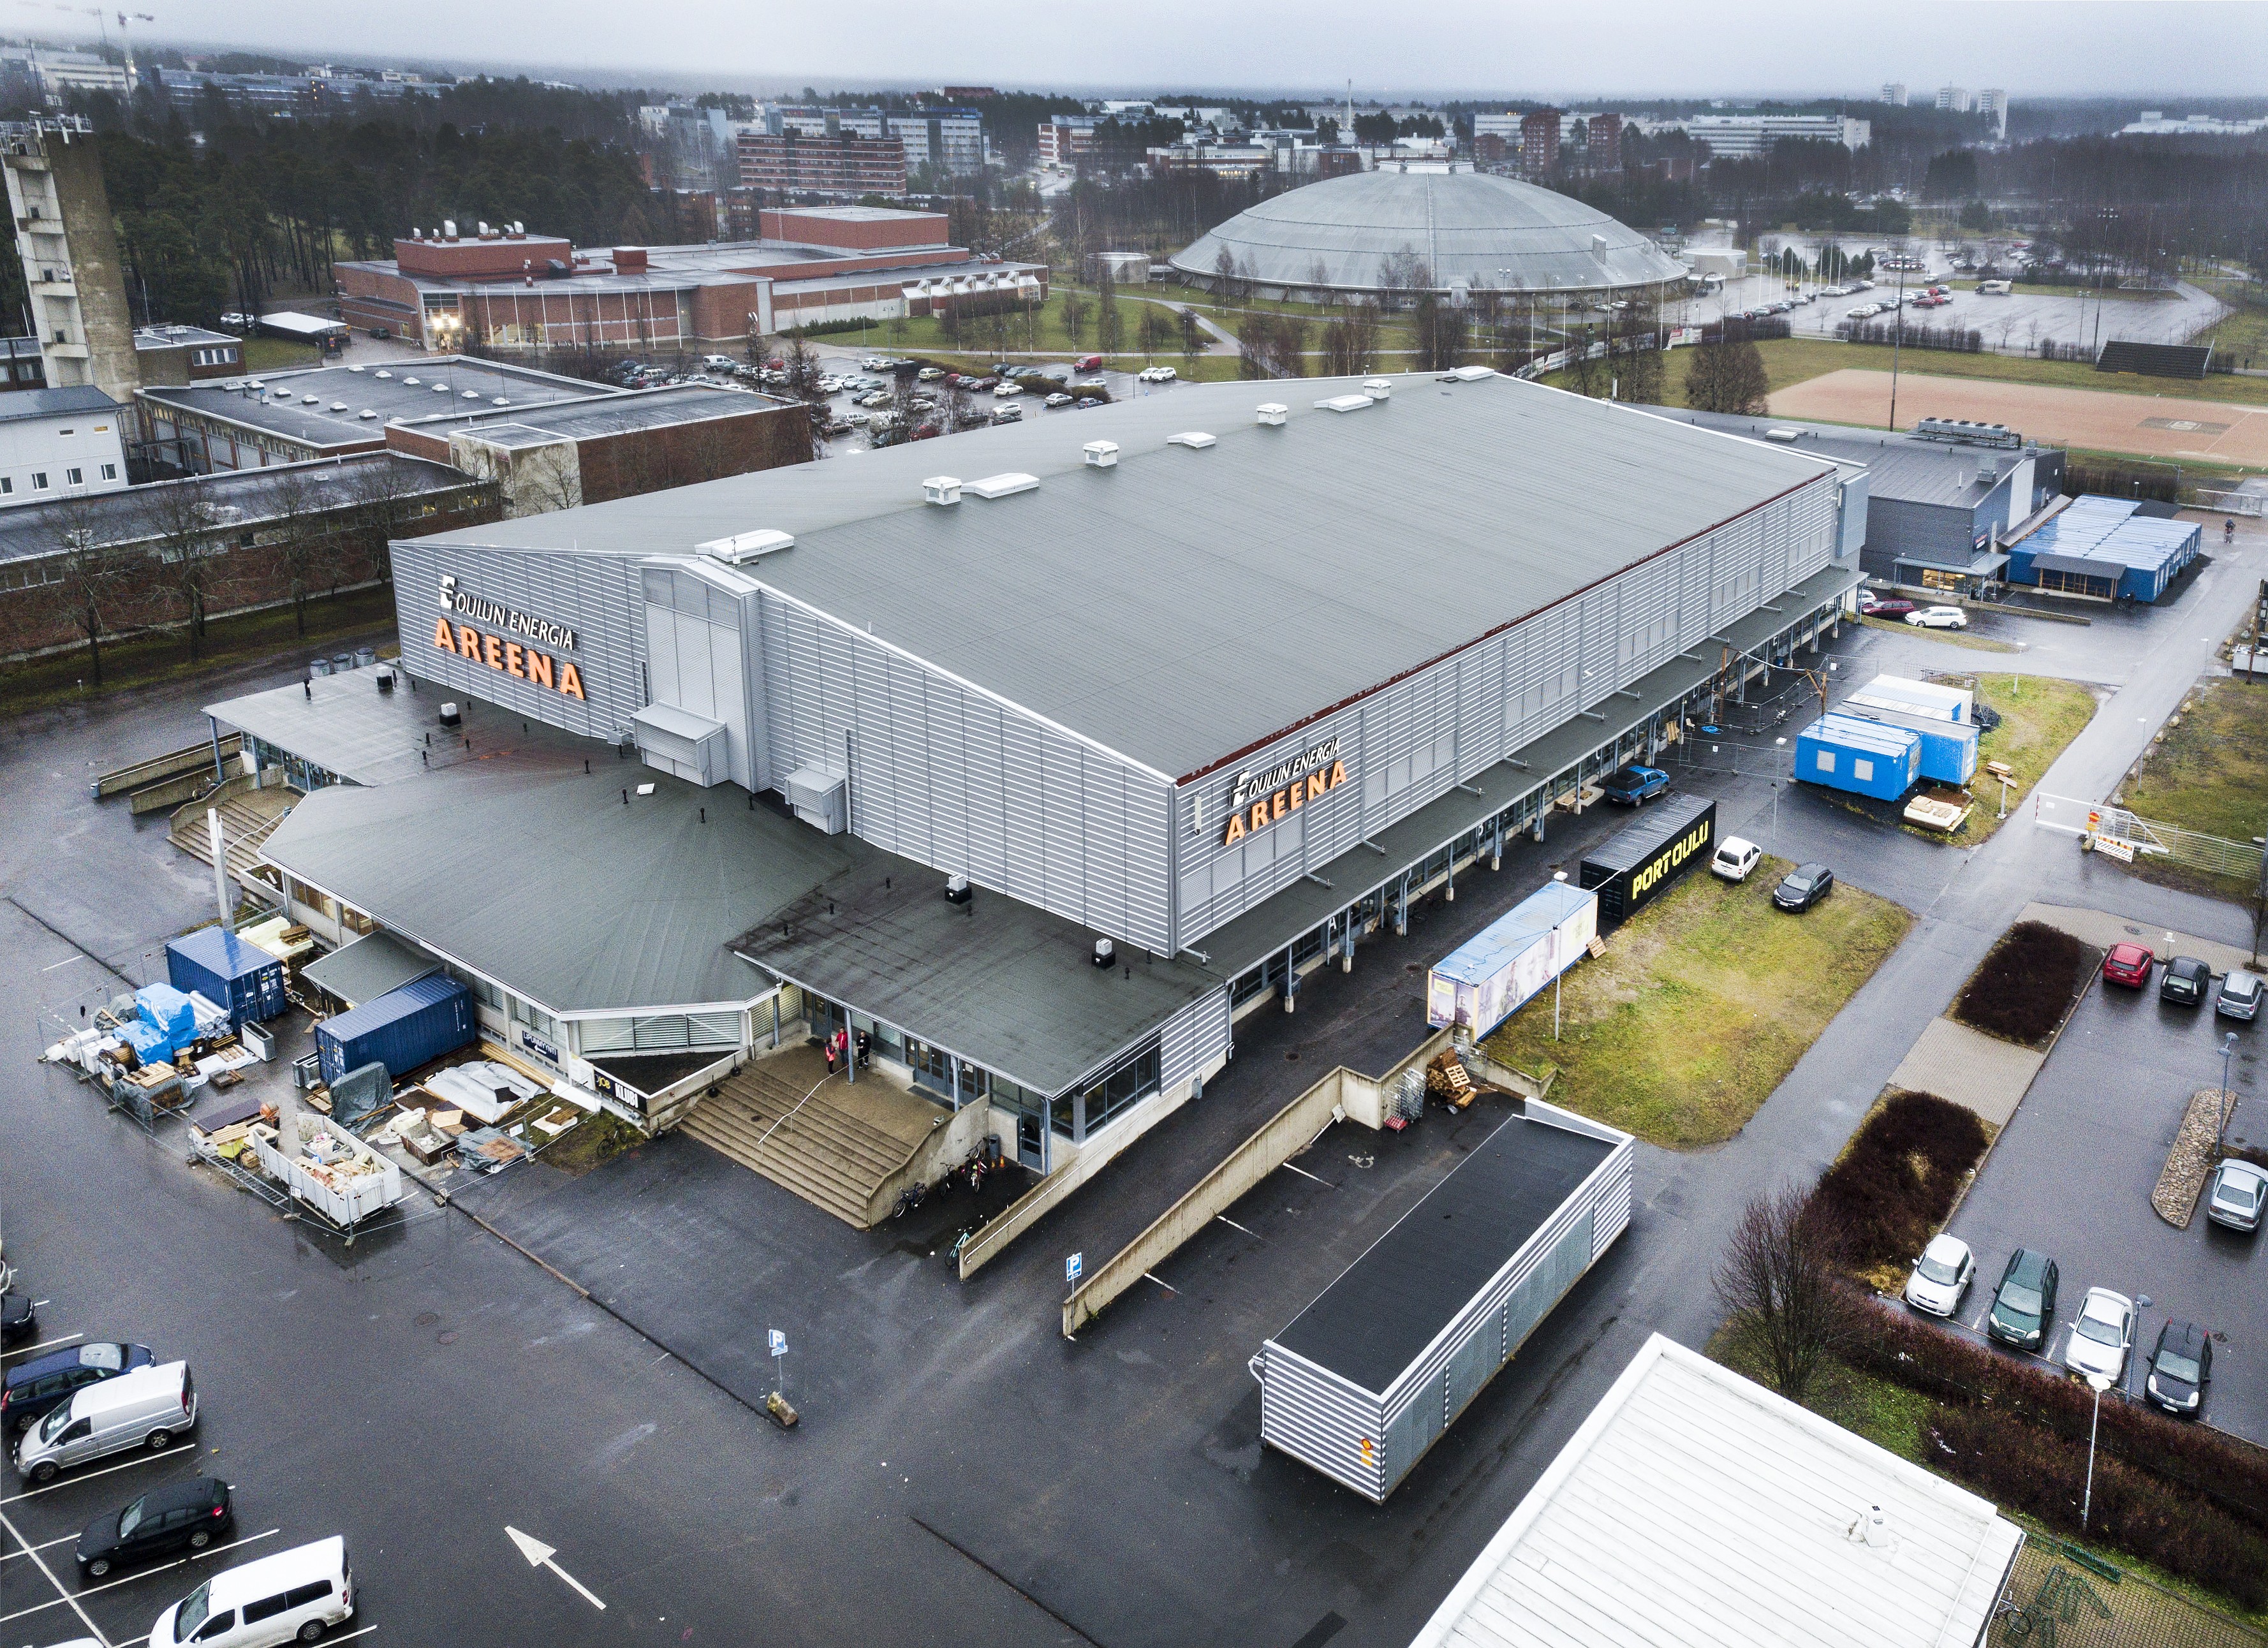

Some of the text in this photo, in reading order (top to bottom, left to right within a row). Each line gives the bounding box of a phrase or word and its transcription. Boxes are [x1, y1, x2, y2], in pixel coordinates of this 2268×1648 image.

[456, 592, 574, 651] OULUN ENERGIA
[434, 617, 586, 700] AREENA
[1249, 737, 1340, 798] OULUN ENERGIA
[1225, 760, 1348, 846] AREENA
[1632, 820, 1709, 899] PORT OULU
[615, 1082, 638, 1108] KLUBI
[1070, 1256, 1080, 1273] P
[772, 1331, 783, 1348] P
